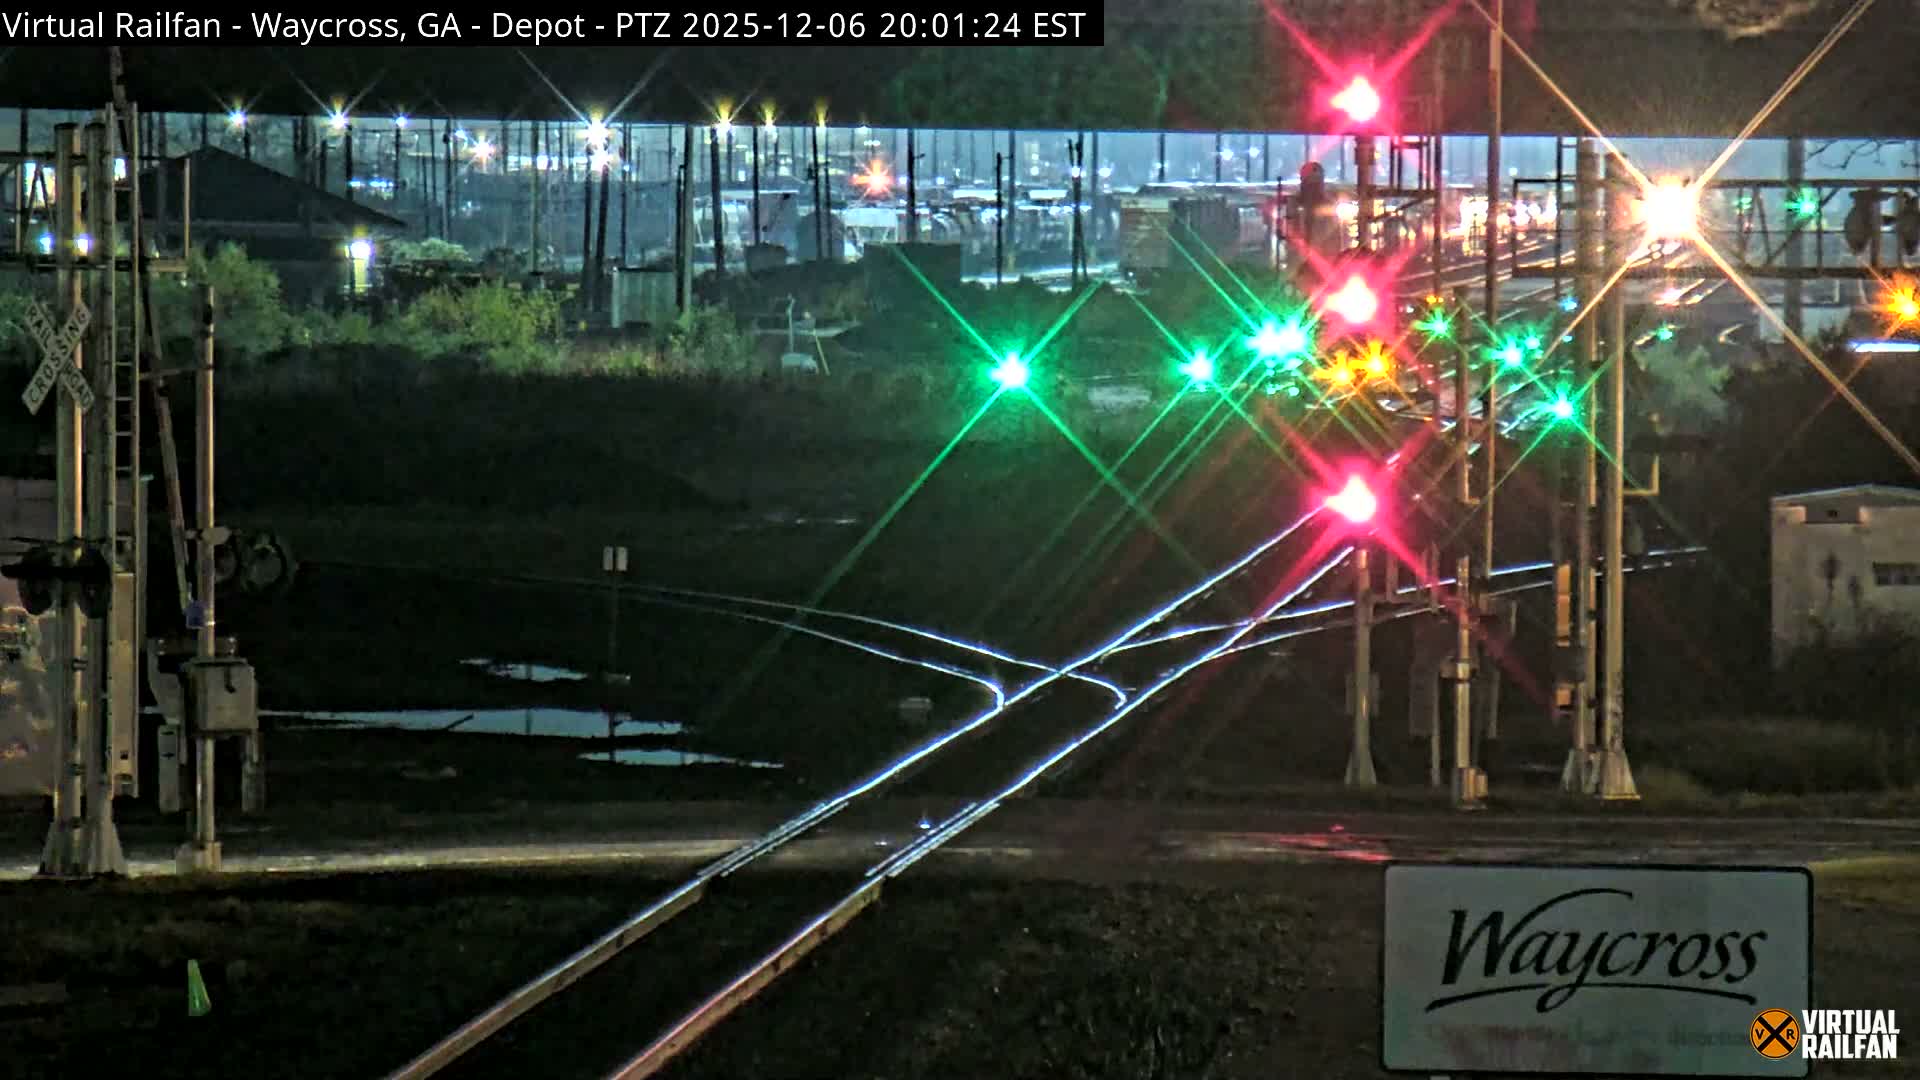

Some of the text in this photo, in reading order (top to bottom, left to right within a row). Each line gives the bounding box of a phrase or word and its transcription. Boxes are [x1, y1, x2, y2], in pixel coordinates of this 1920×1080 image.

[27, 304, 51, 350] RAIL
[27, 306, 88, 404] CROSSING
[62, 361, 93, 406] ROAD
[1438, 888, 1768, 1013] Waycross
